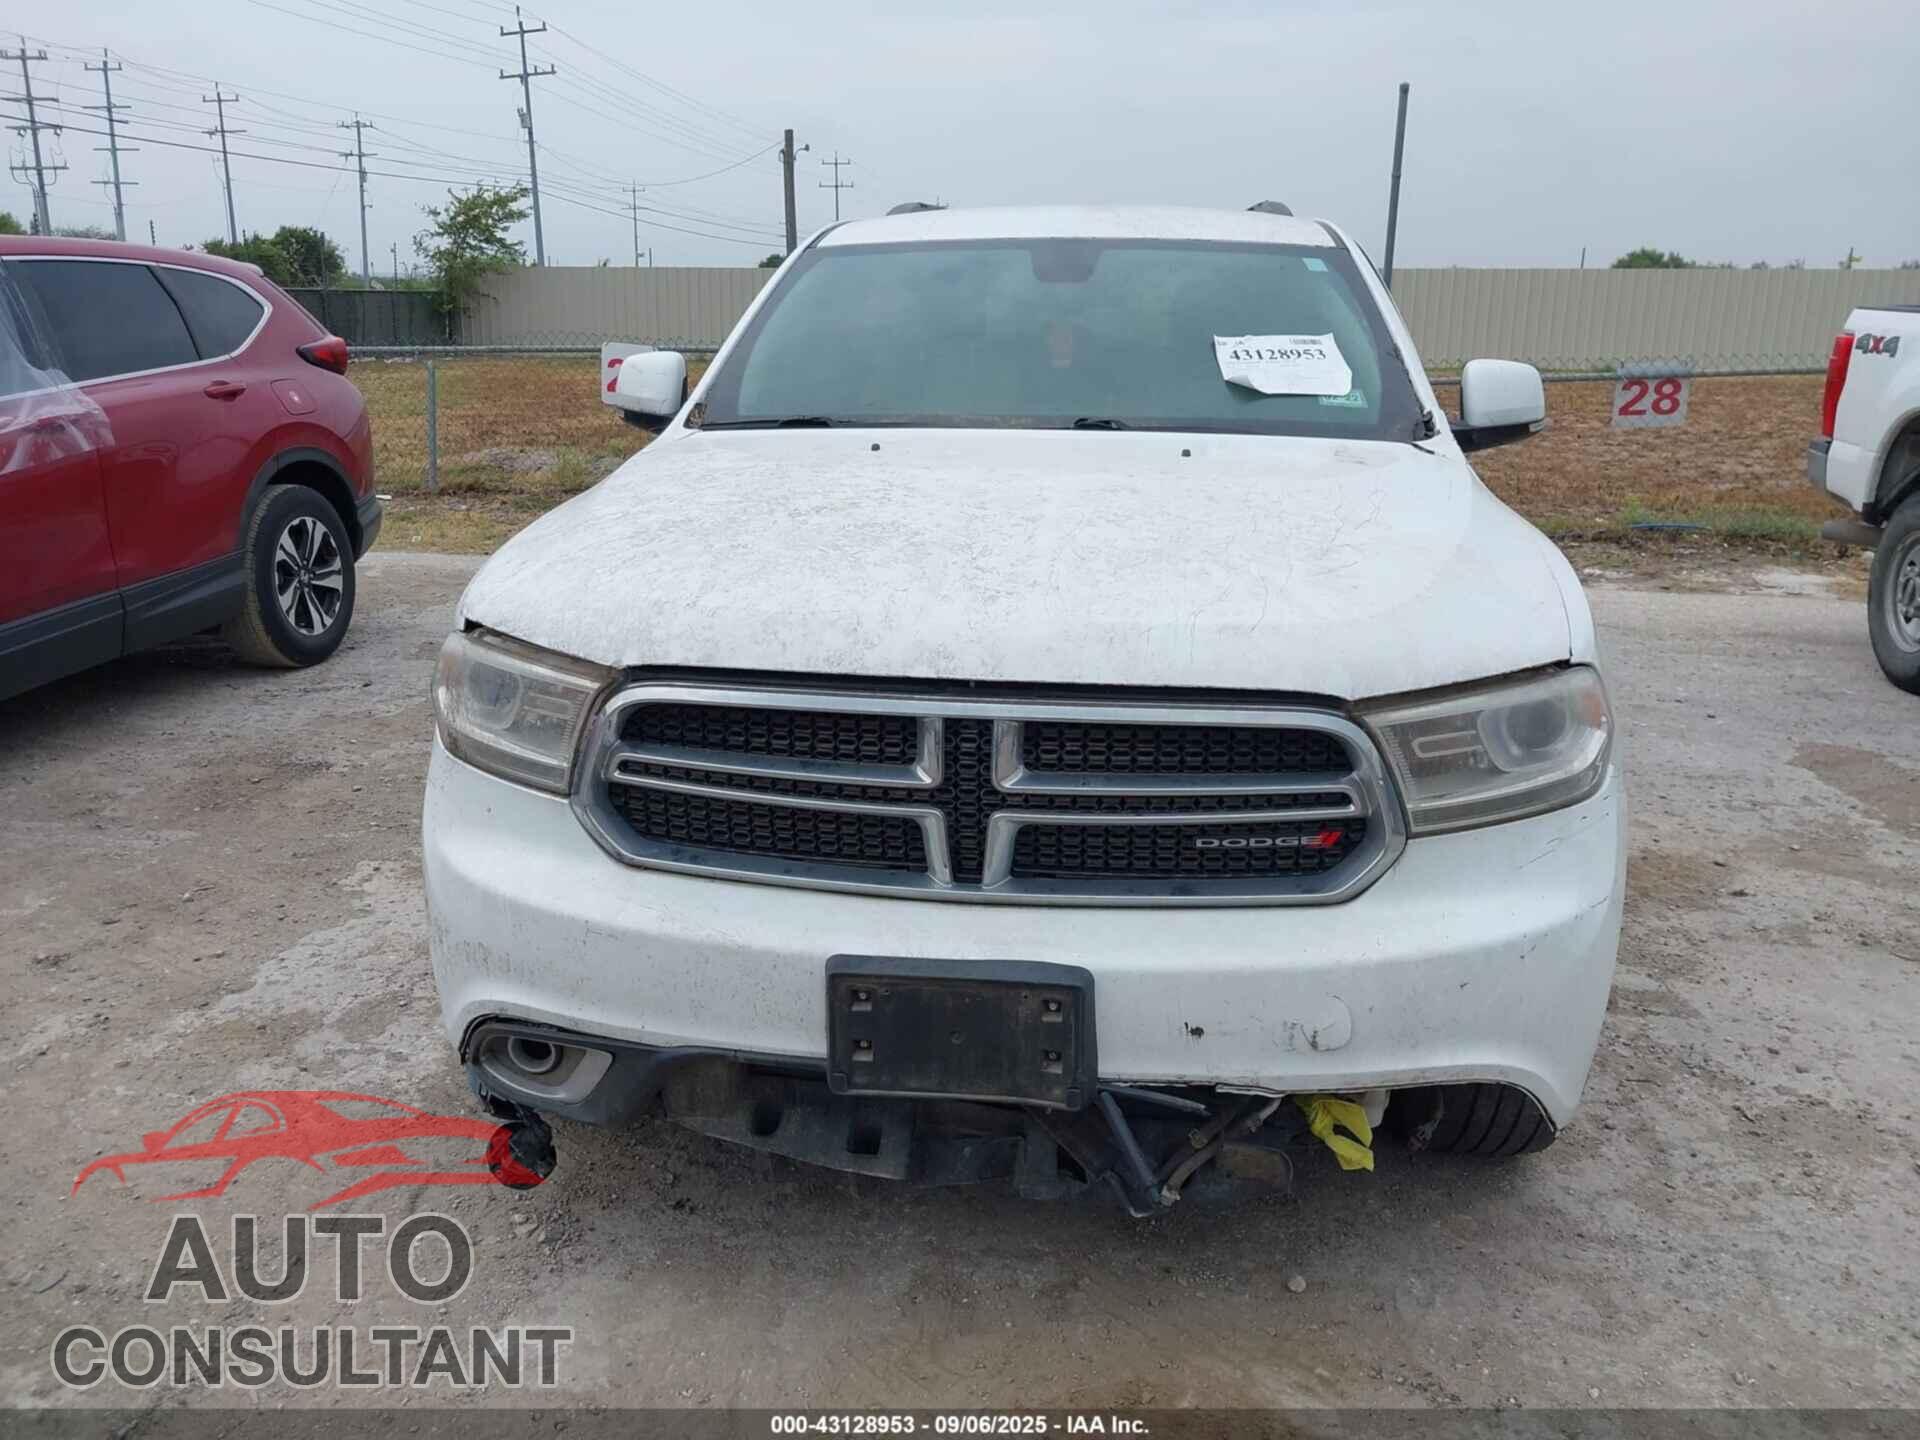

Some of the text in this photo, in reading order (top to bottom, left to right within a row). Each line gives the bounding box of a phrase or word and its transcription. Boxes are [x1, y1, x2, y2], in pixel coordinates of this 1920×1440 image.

[1229, 348, 1327, 361] 43128953
[1618, 376, 1682, 416] 28
[1195, 836, 1324, 848] DODGE
